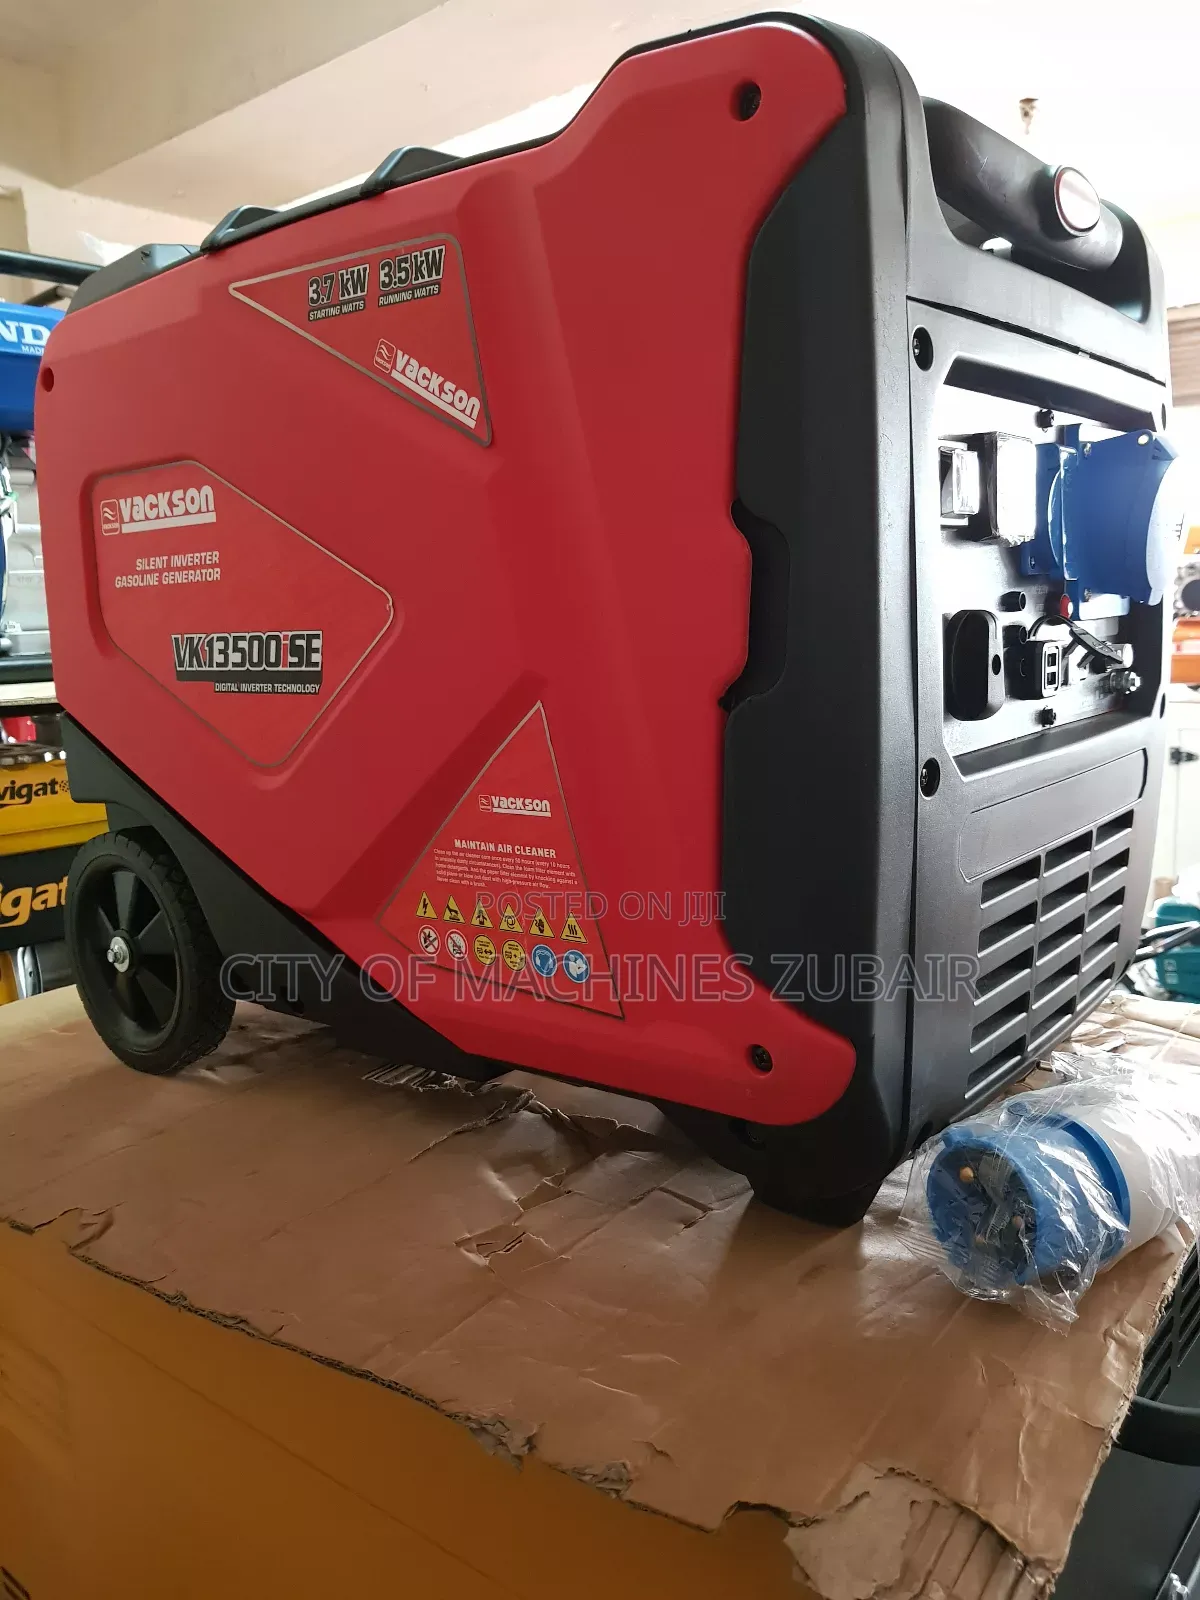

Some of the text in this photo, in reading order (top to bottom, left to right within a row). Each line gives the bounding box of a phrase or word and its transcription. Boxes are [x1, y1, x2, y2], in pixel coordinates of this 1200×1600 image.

[380, 245, 446, 291] 3.5 kW
[308, 264, 369, 306] 3.7 kW
[379, 284, 439, 306] RUNNING WATTS
[310, 301, 365, 320] STARTING WATTS
[136, 551, 220, 571] SILENT INVERTER
[115, 568, 221, 588] GASOLINE GENERATOR
[172, 631, 323, 671] VK13500iSE
[215, 682, 321, 693] DIGITAL INVERTER TECHNOLOGY
[454, 839, 556, 859] MAINTAIN AIR CLEANER
